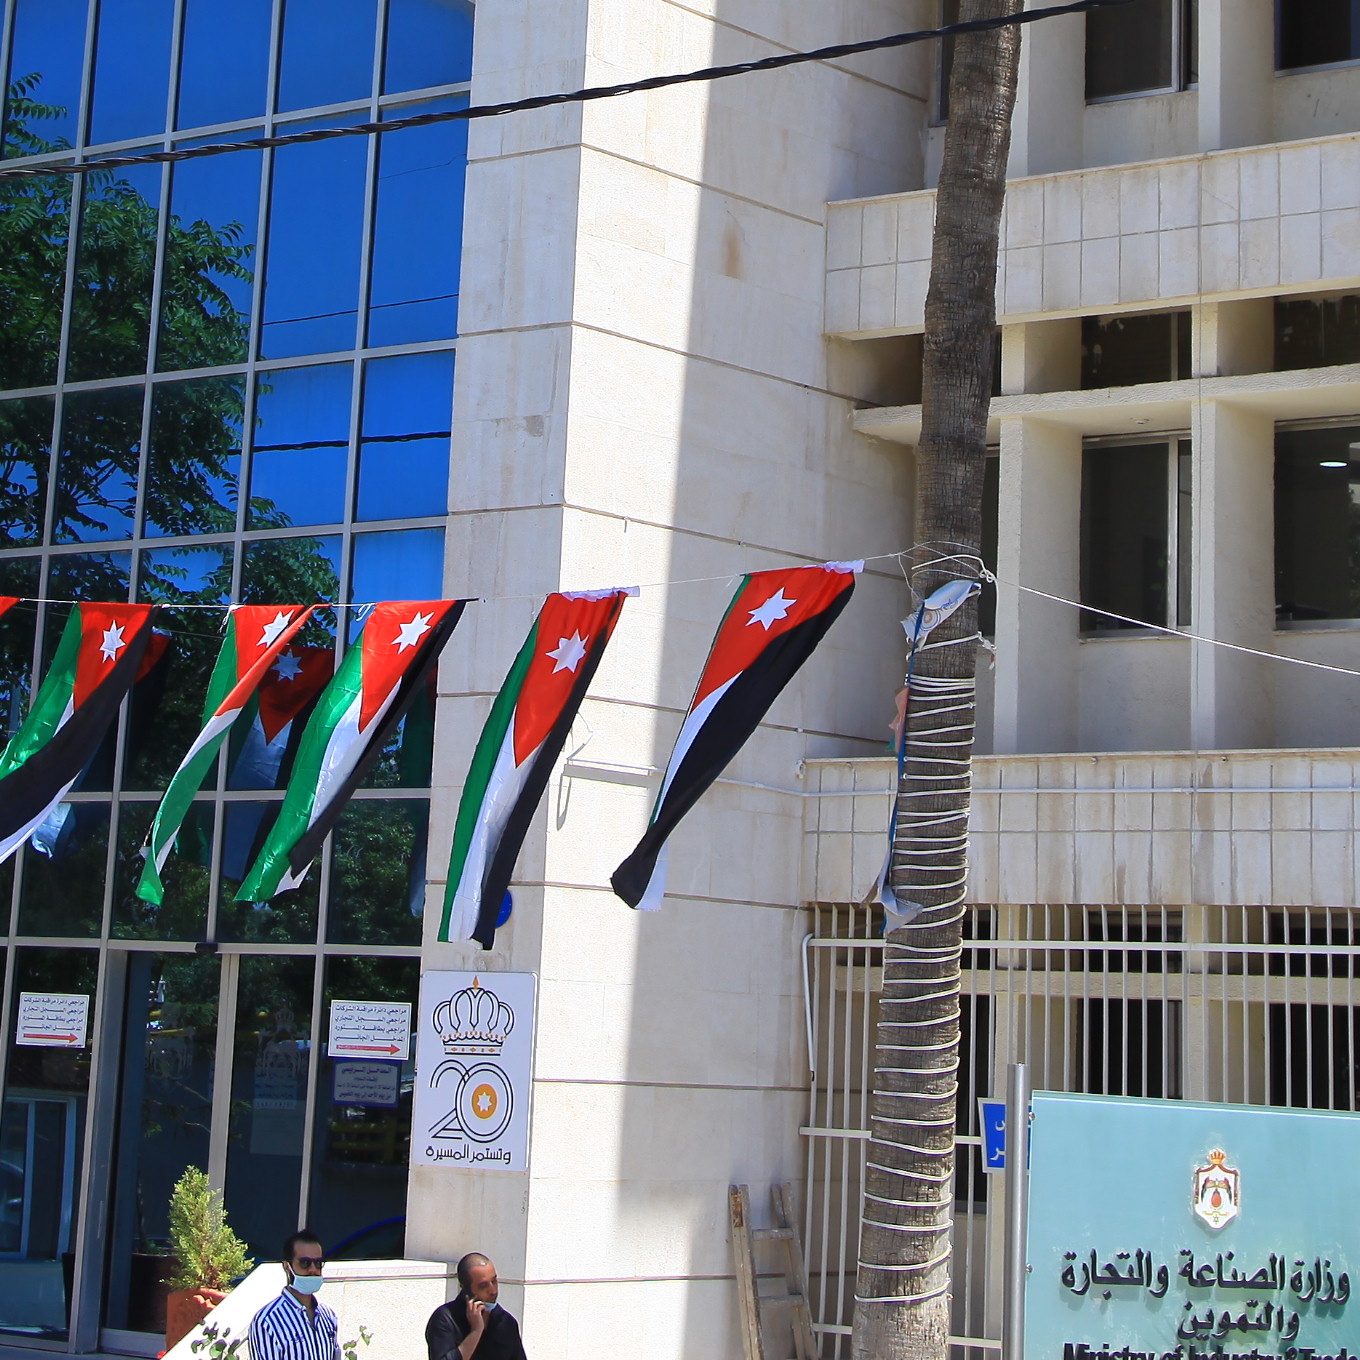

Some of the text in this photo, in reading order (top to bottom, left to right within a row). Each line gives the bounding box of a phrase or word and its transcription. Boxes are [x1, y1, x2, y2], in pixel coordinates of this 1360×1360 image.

[428, 1059, 514, 1143] 20
[425, 1144, 511, 1165] وتستمر المسيرة
[1061, 1248, 1351, 1305] وزارة الصناعة والتجارة
[1177, 1300, 1300, 1341] والتموين
